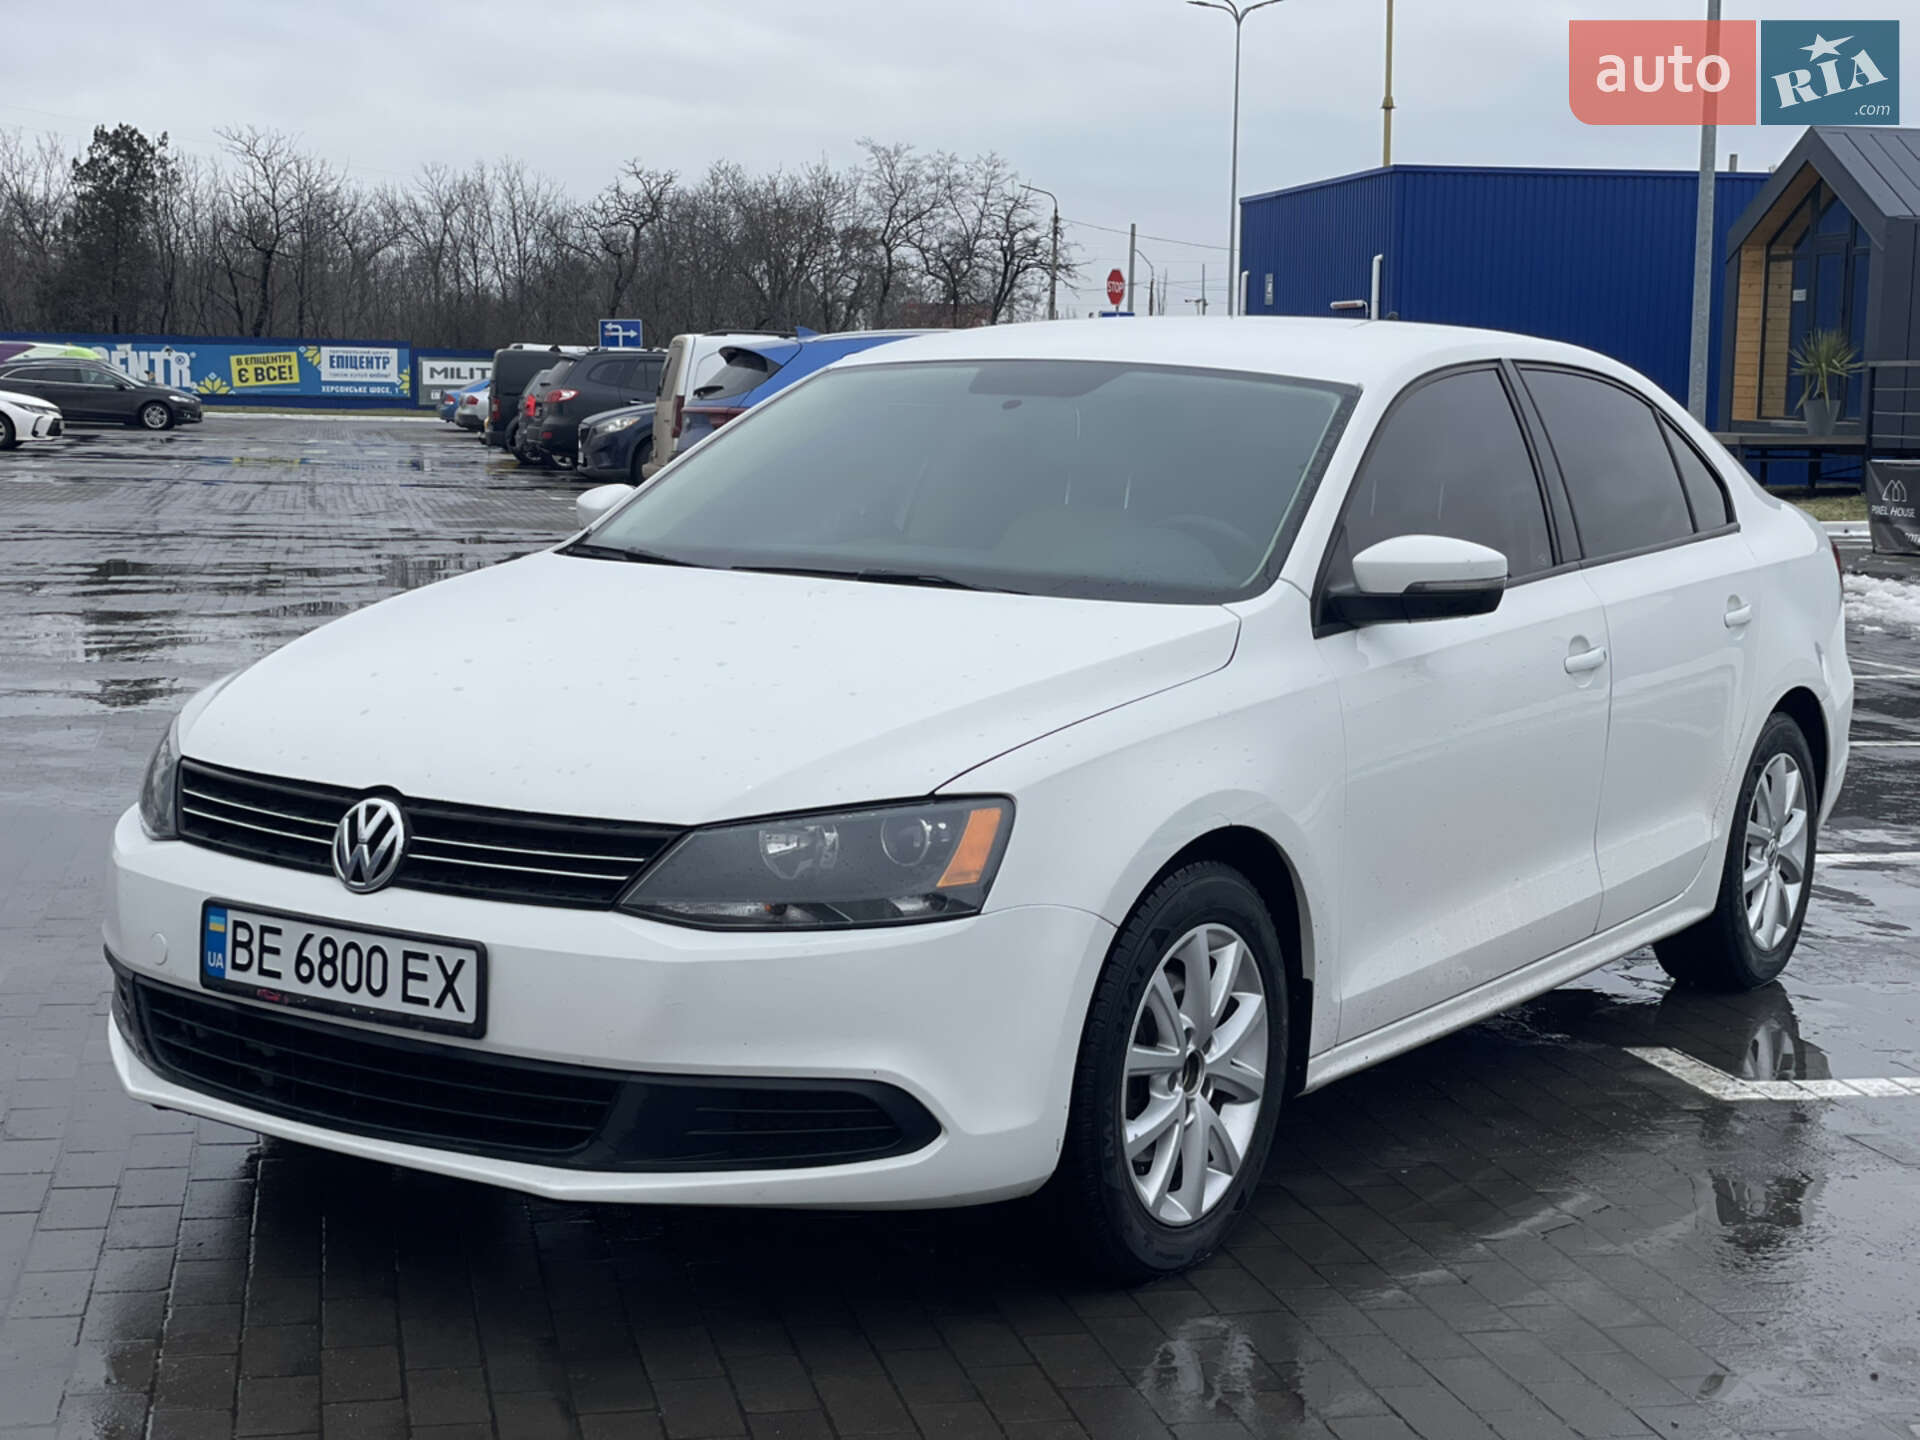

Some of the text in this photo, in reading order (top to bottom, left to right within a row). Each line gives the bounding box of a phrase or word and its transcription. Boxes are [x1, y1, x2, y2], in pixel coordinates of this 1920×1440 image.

[1107, 281, 1125, 293] STOP
[329, 355, 391, 370] ЕПІЦЕНТР
[238, 365, 294, 383] Є ВСЕ!
[1890, 506, 1916, 518] HOUSE
[207, 951, 224, 970] UA
[294, 932, 389, 998] 6800
